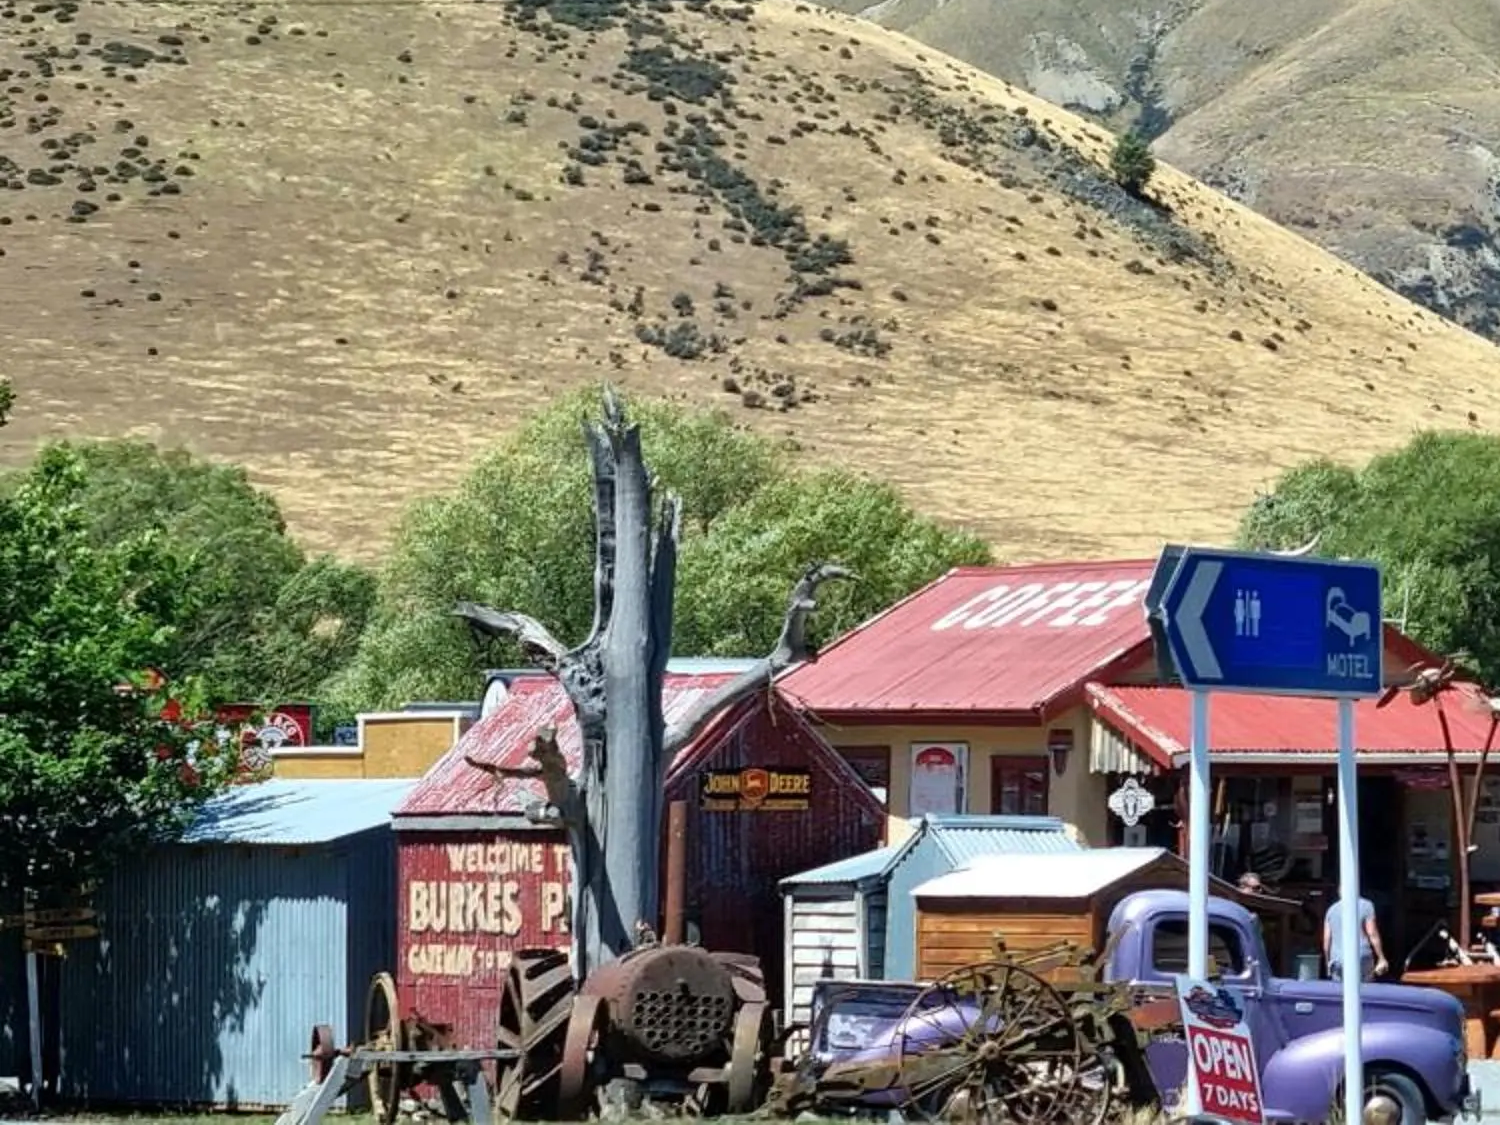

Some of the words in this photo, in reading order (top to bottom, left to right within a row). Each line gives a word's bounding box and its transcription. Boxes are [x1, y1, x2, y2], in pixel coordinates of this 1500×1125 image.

[930, 578, 1152, 631] COFFEE
[1327, 653, 1373, 679] MOTEL
[703, 772, 741, 794] JOHN
[769, 772, 811, 794] DEERE
[447, 841, 545, 874] WELCOME
[409, 880, 523, 937] BURKES
[1193, 1032, 1253, 1084] OPEN
[1202, 1082, 1214, 1103] 7
[1215, 1085, 1259, 1113] DAYS
